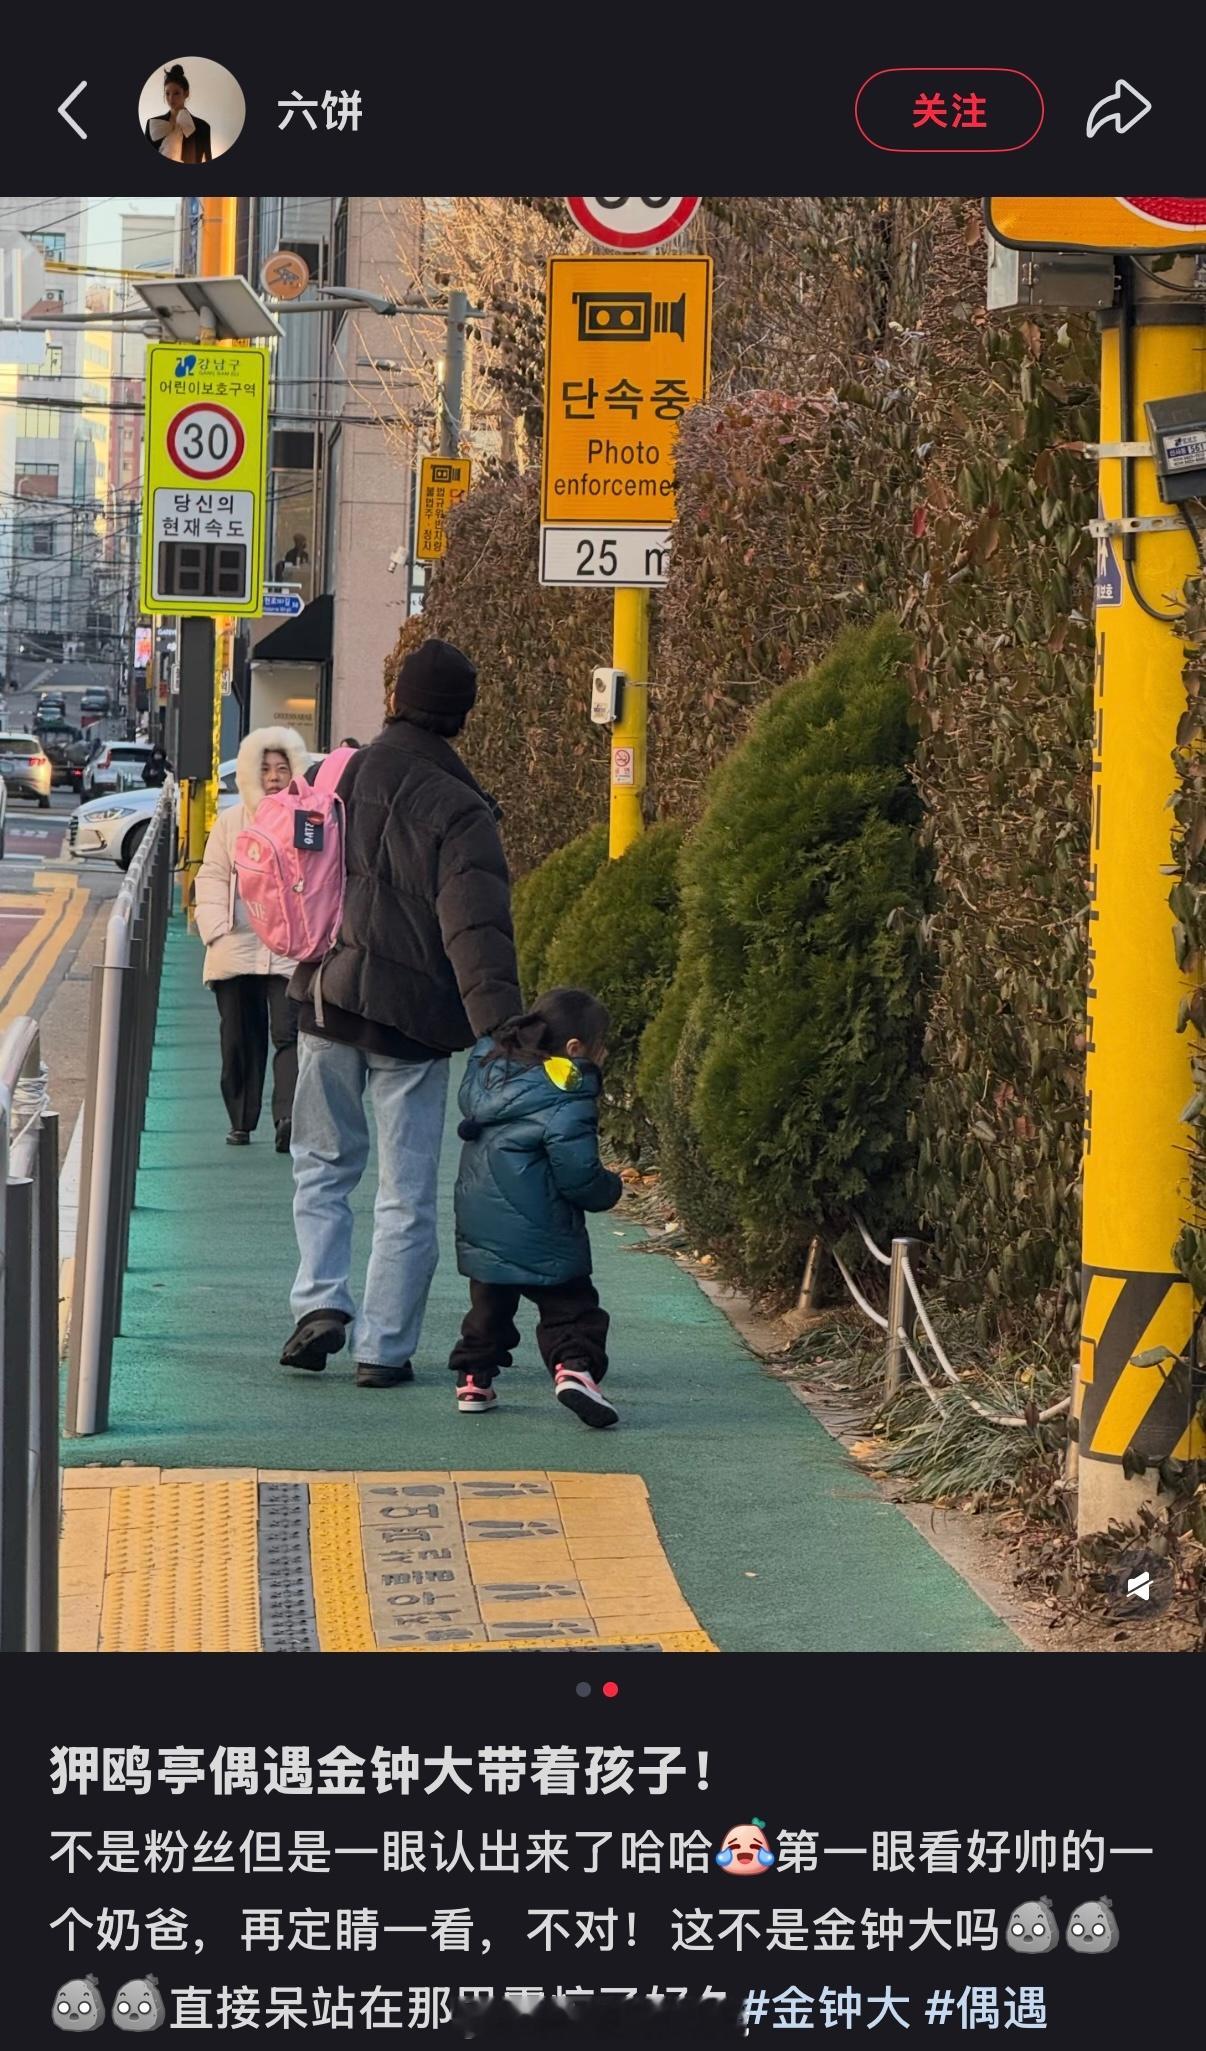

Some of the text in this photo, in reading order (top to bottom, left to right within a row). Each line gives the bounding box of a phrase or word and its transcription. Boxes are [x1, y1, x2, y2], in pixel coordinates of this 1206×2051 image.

[198, 358, 240, 371] 강남구
[160, 380, 256, 397] 어린이보호구역
[562, 378, 690, 420] 단속중
[183, 423, 228, 460] 30
[588, 439, 660, 465] Photo
[554, 473, 677, 496] enforceme
[174, 494, 234, 515] 당신의
[162, 517, 245, 538] 현재속도
[576, 539, 617, 576] 25
